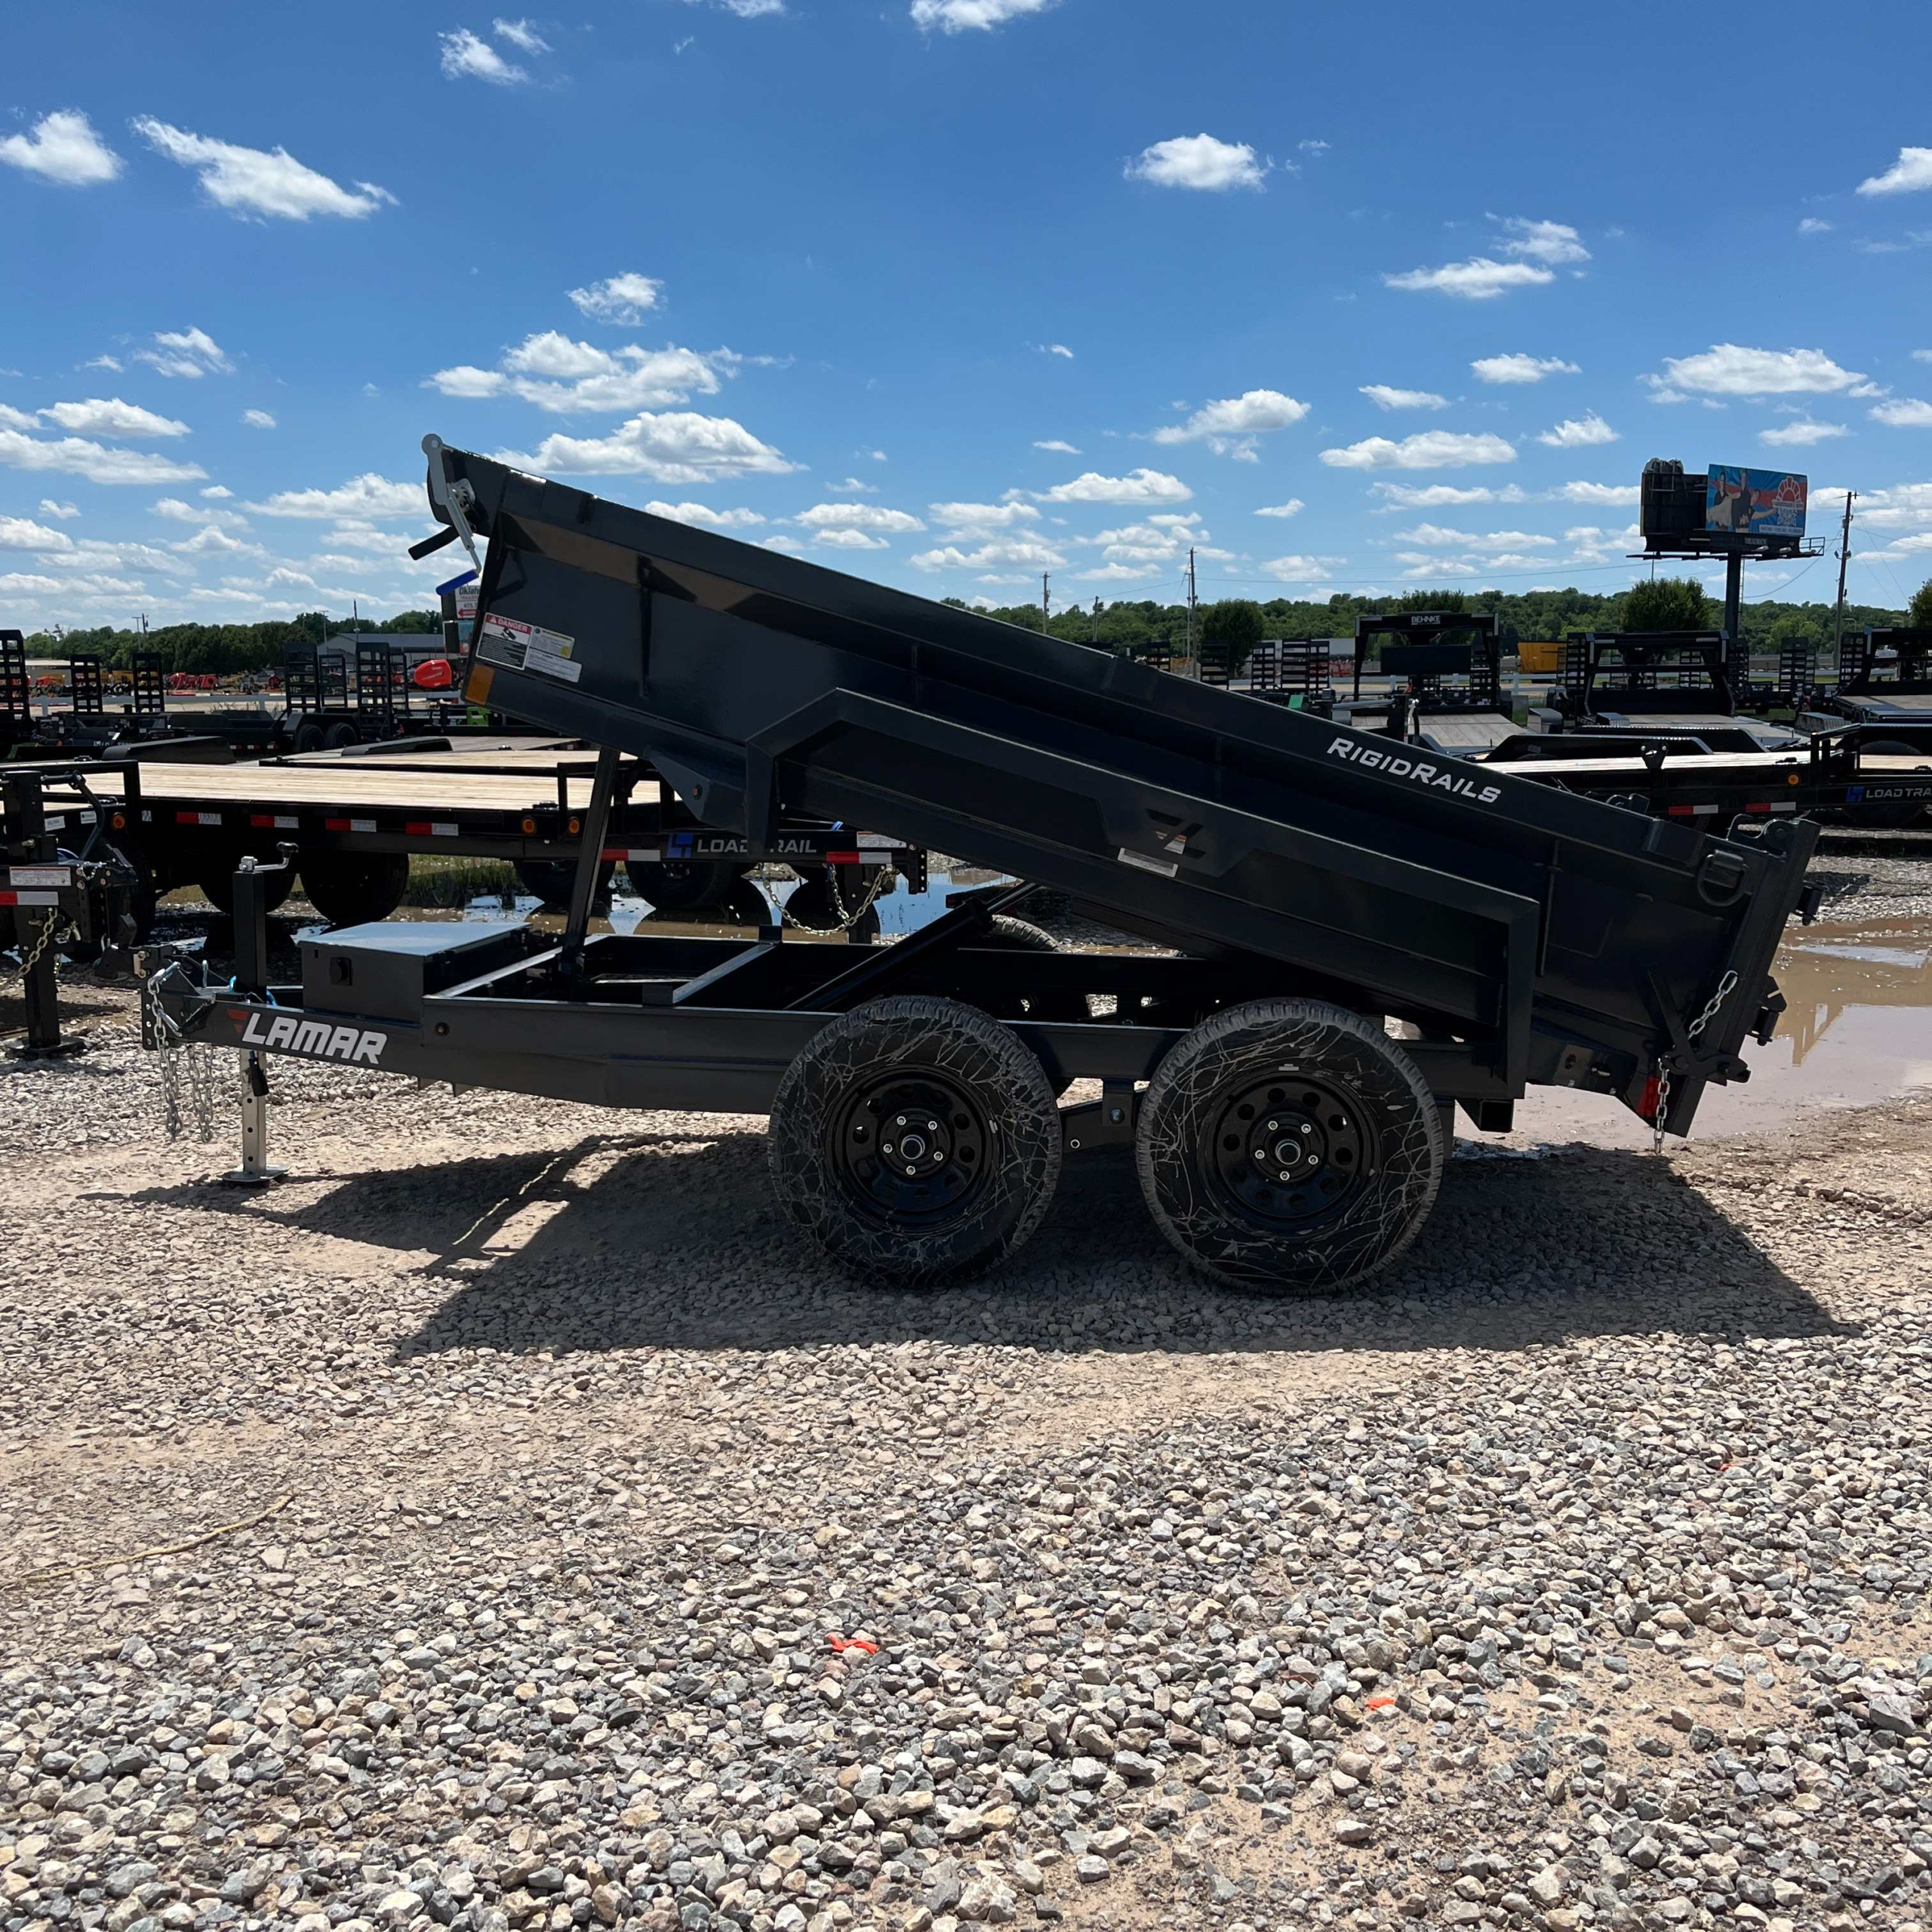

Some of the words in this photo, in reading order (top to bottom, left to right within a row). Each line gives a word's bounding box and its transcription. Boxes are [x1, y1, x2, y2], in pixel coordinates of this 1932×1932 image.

[497, 617, 528, 632] DANGER
[1866, 789, 1903, 798] LOAD
[769, 839, 817, 853] RAIL
[242, 1012, 388, 1065] LAMAR
